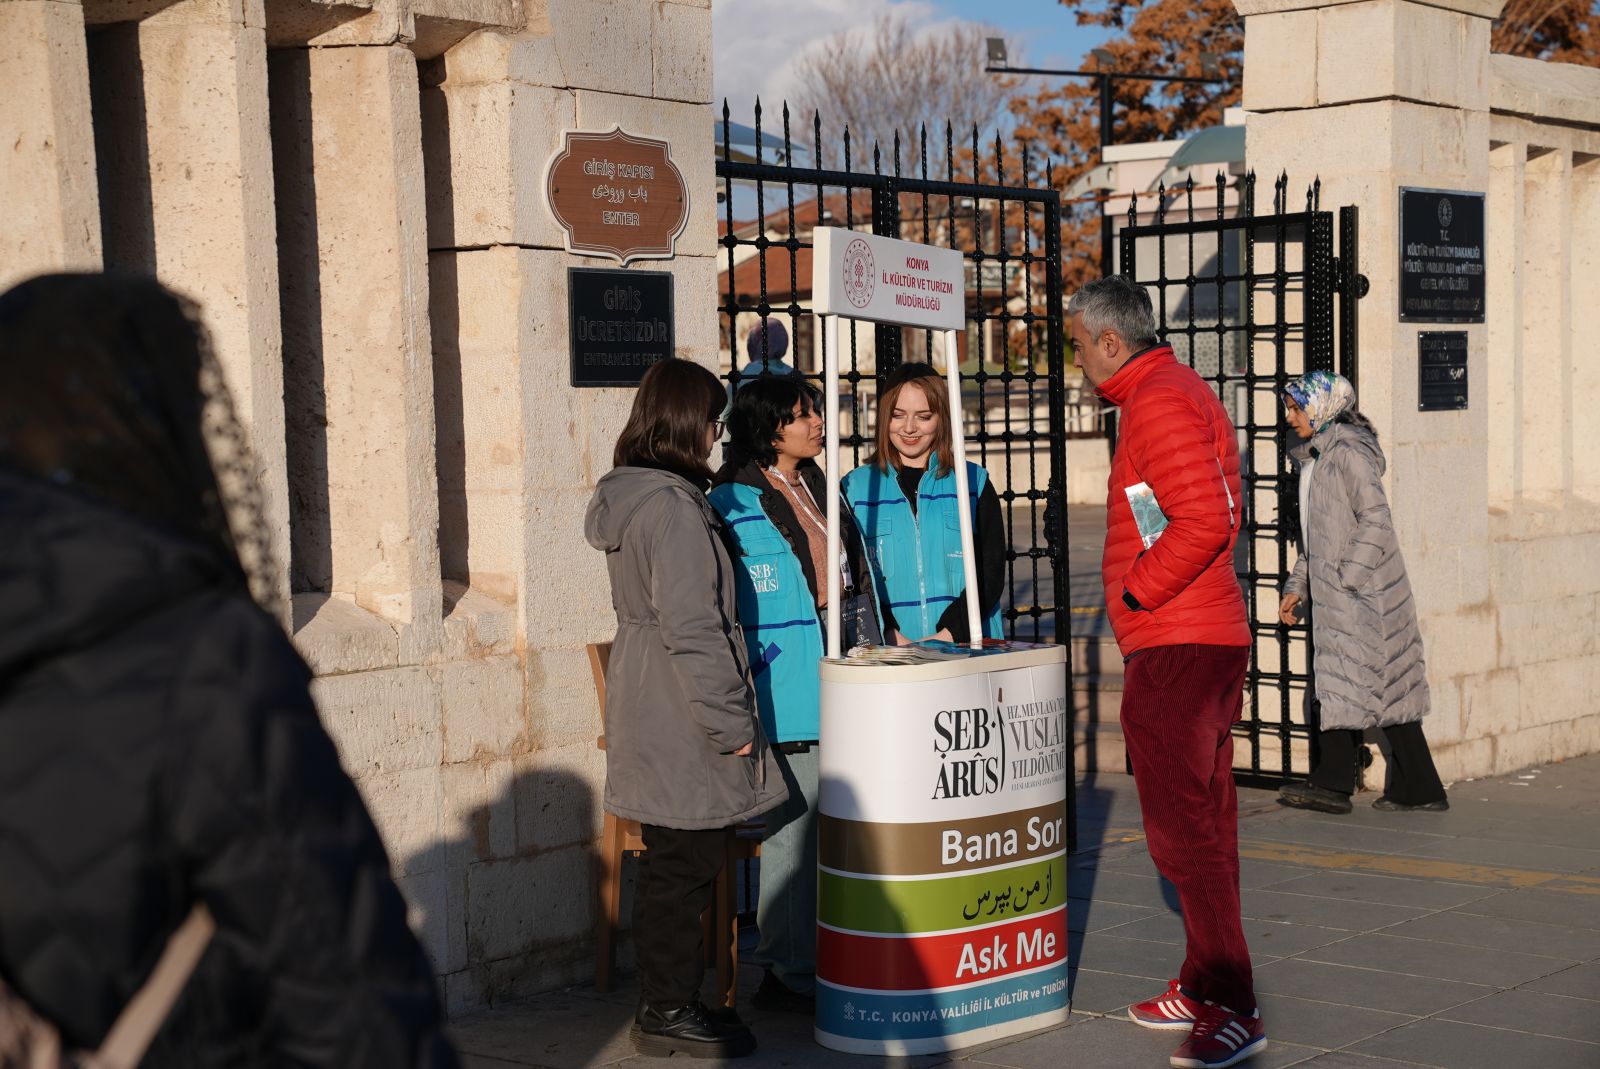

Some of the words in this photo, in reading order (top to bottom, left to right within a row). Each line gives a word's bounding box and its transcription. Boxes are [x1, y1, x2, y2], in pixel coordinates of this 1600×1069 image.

[583, 157, 616, 180] GİRİŞ
[617, 163, 655, 180] KAPISI
[628, 183, 648, 204] باب
[602, 211, 640, 226] ENTER
[906, 256, 929, 271] KONYA
[882, 269, 889, 284] İL
[890, 271, 916, 289] KÜLTÜR
[917, 278, 926, 290] VE
[926, 278, 953, 294] TURİZM
[603, 285, 642, 313] GİRİŞ
[895, 291, 941, 311] MÜDÜRLÜĞÜ
[577, 315, 668, 342] ÜCRETSİZDİR
[583, 352, 631, 366] ENTRANCE
[632, 352, 641, 366] IS
[1009, 713, 1065, 753] VUSLAT
[941, 826, 1018, 865] Bana
[1026, 815, 1062, 852] Sor
[1013, 879, 1040, 912] من
[1039, 863, 1053, 905] از
[962, 886, 1012, 921] بپرس
[955, 934, 1008, 979] Ask
[1016, 927, 1057, 966] Me
[858, 1009, 885, 1022] T.C.
[892, 1009, 938, 1023] KONYA
[940, 999, 982, 1020] VALİLİĞİ
[983, 997, 992, 1011] İL
[994, 986, 1029, 1008] KÜLTÜR
[1030, 989, 1040, 999] ve
